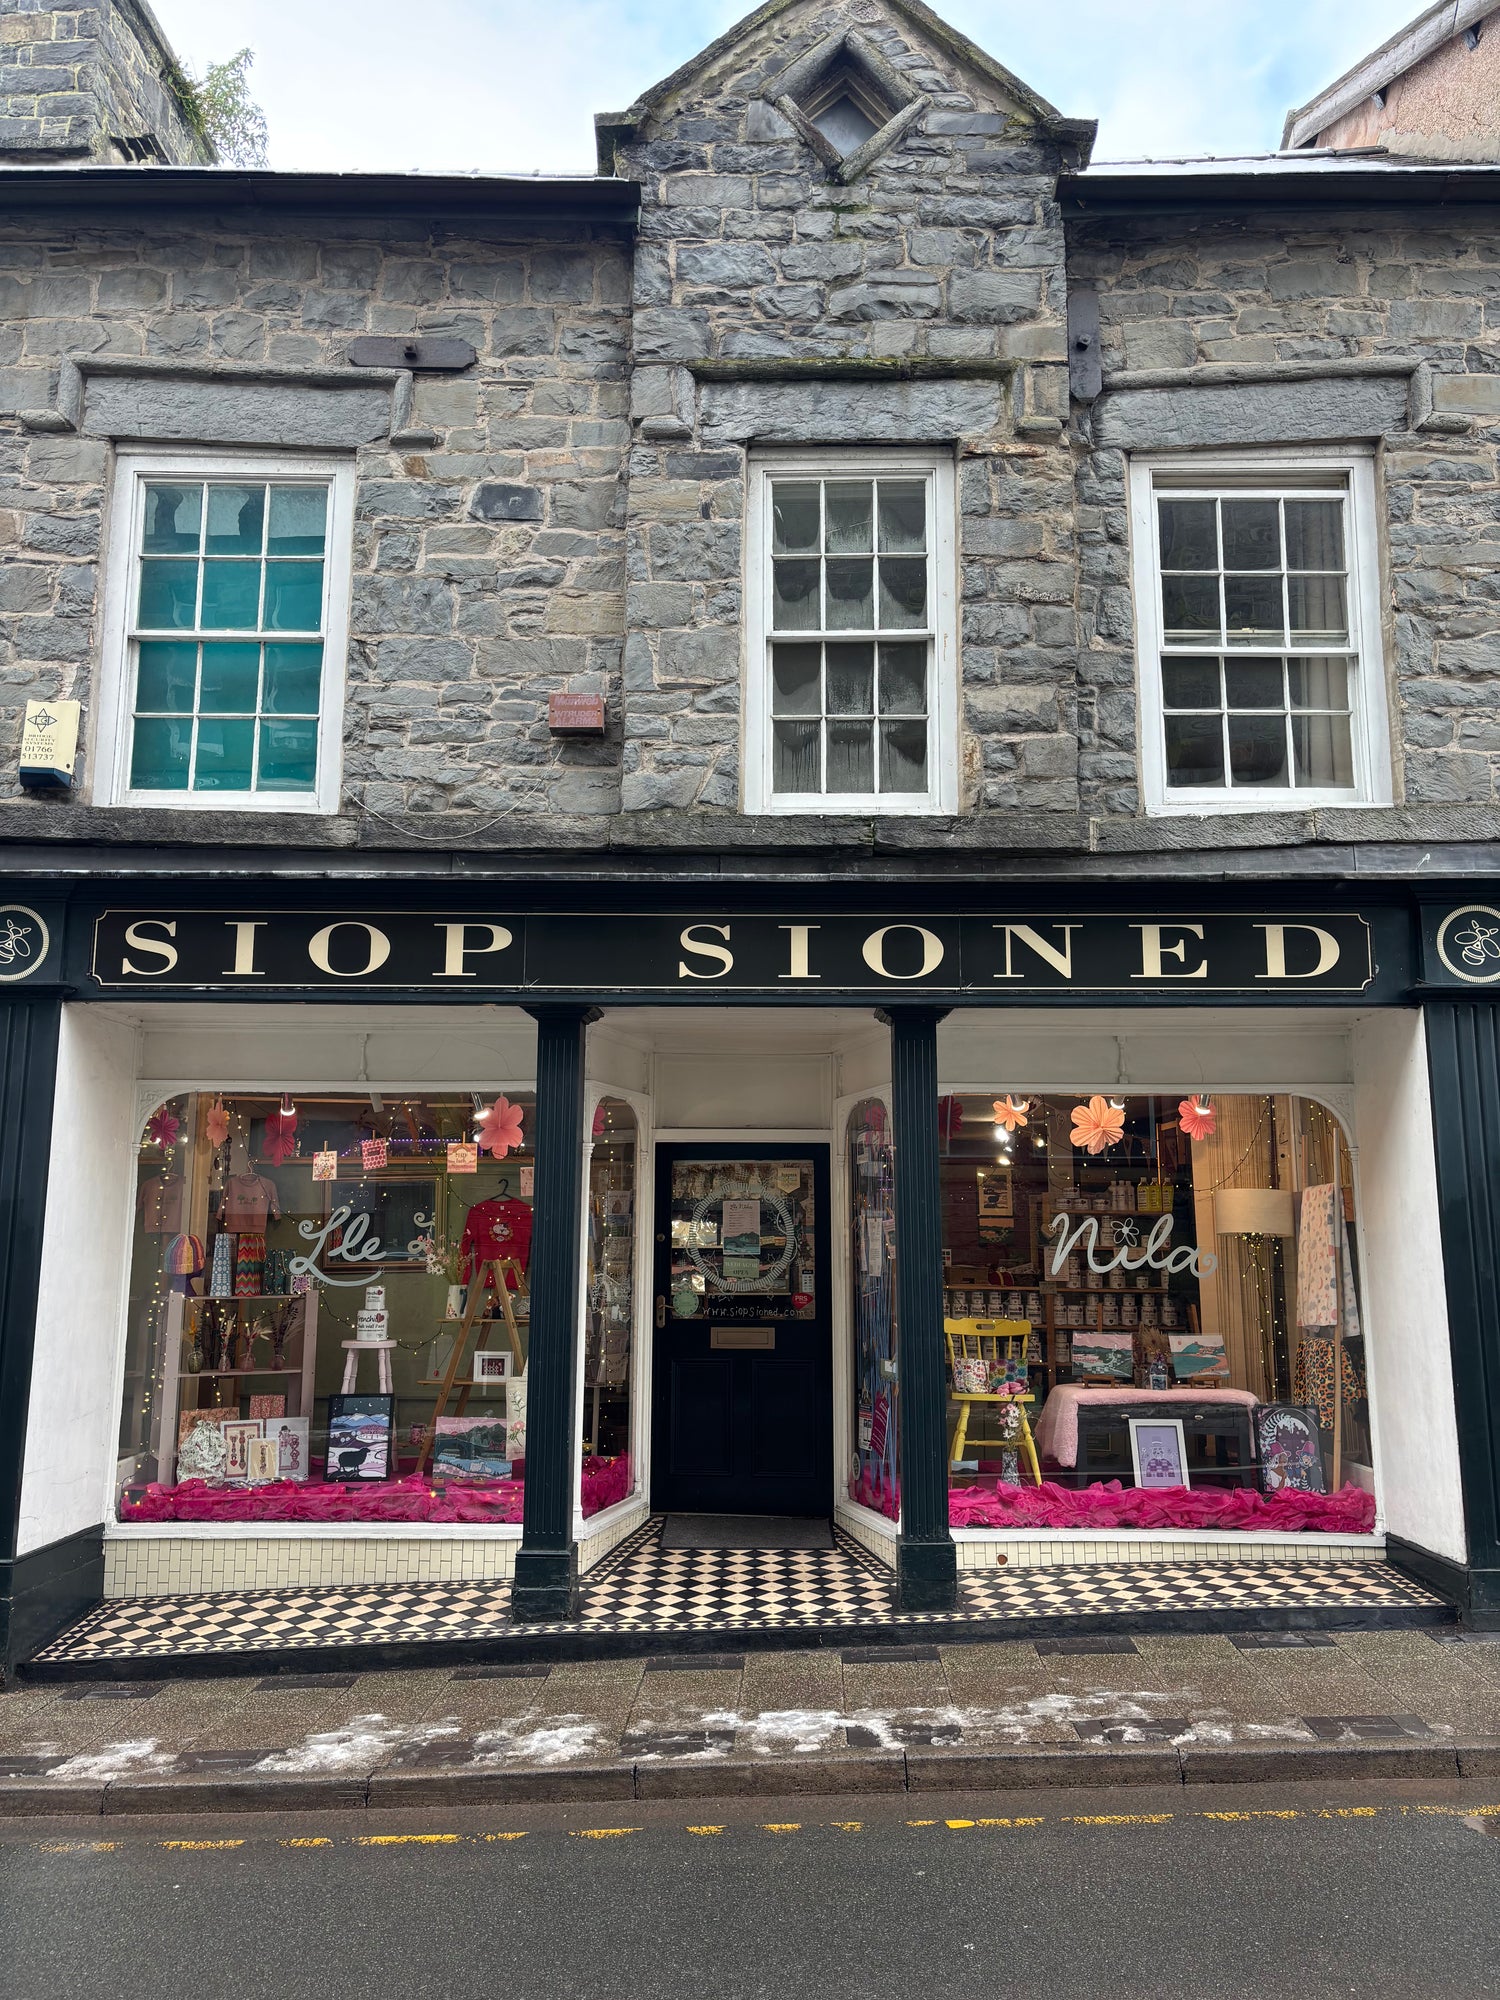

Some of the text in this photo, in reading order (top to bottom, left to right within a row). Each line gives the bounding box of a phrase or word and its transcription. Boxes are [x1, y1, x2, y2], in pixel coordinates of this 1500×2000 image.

[554, 710, 597, 718] INTRUDER
[555, 717, 598, 726] ALARMS
[122, 921, 1340, 979] SIOP SIONED
[289, 1205, 387, 1287] Lle
[1048, 1212, 1218, 1279] Nila
